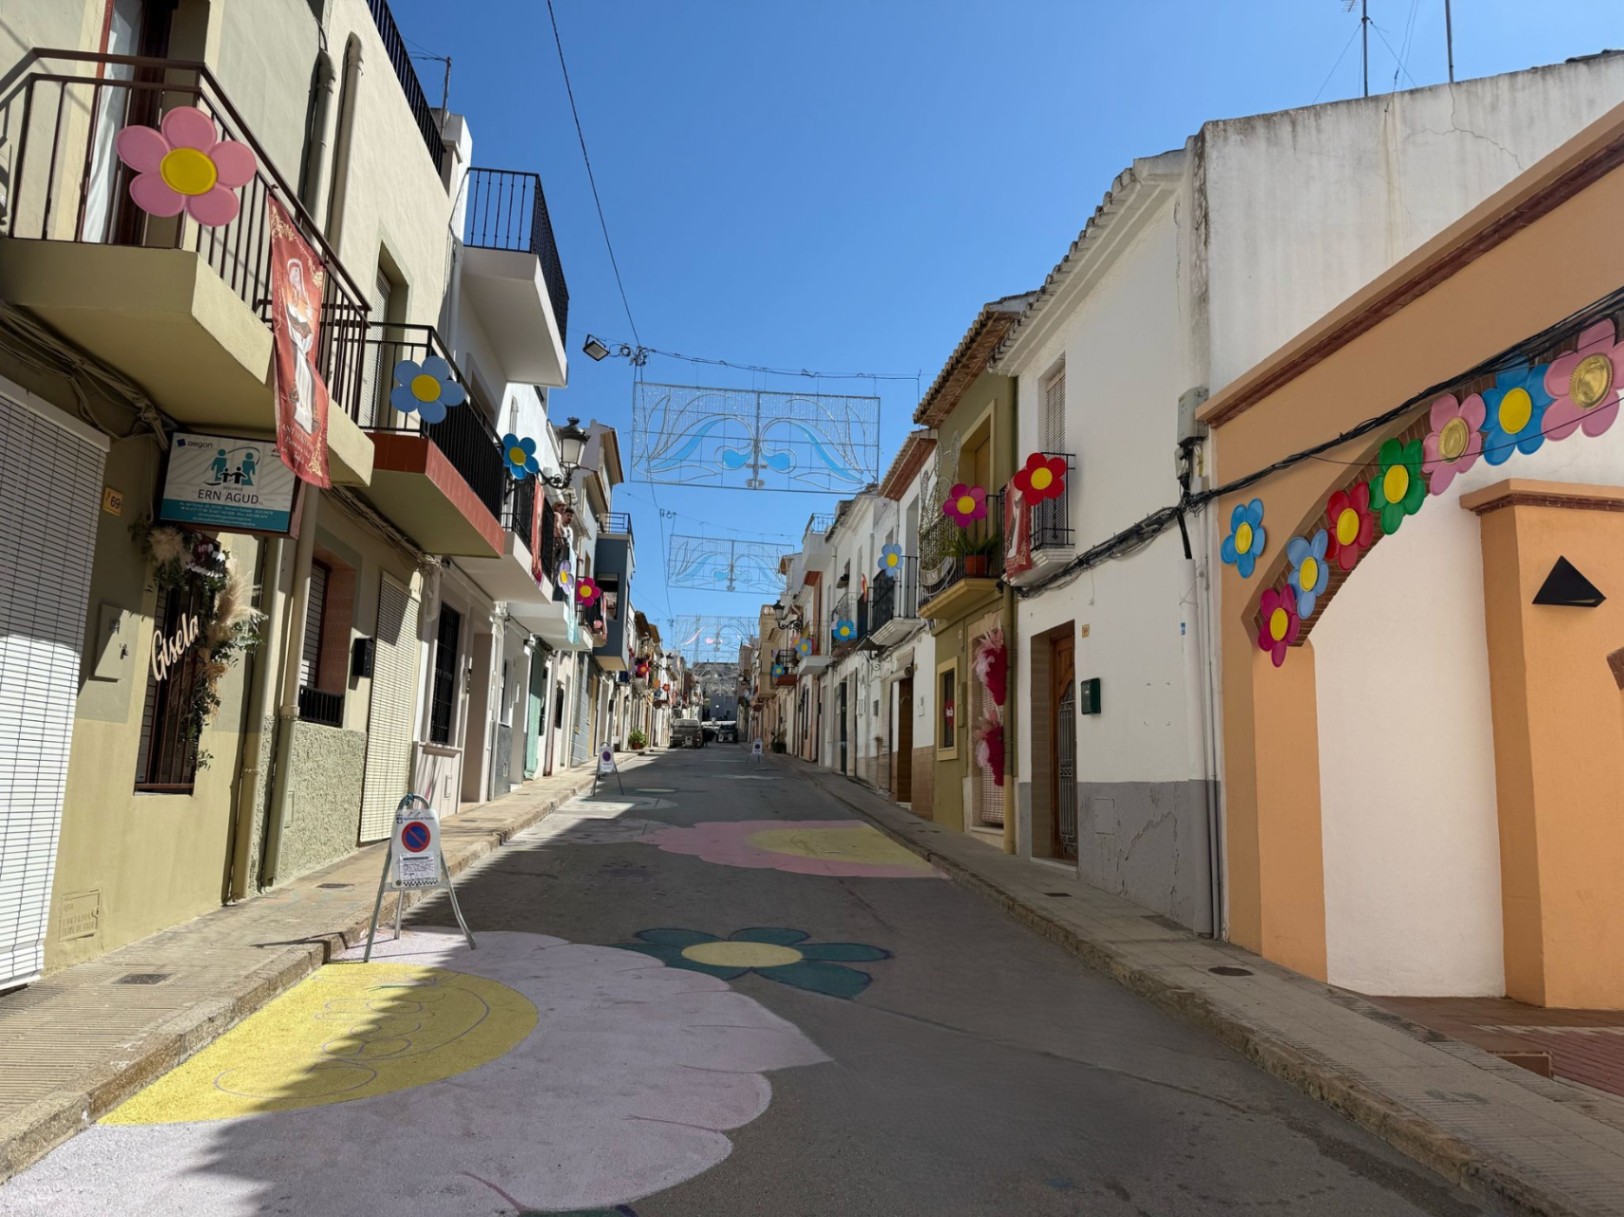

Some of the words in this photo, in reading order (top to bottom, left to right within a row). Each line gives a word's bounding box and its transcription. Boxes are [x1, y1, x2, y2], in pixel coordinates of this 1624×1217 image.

[187, 441, 214, 449] aegon
[197, 488, 222, 501] ERN
[225, 492, 259, 505] AGUD
[152, 612, 200, 682] Gisela
